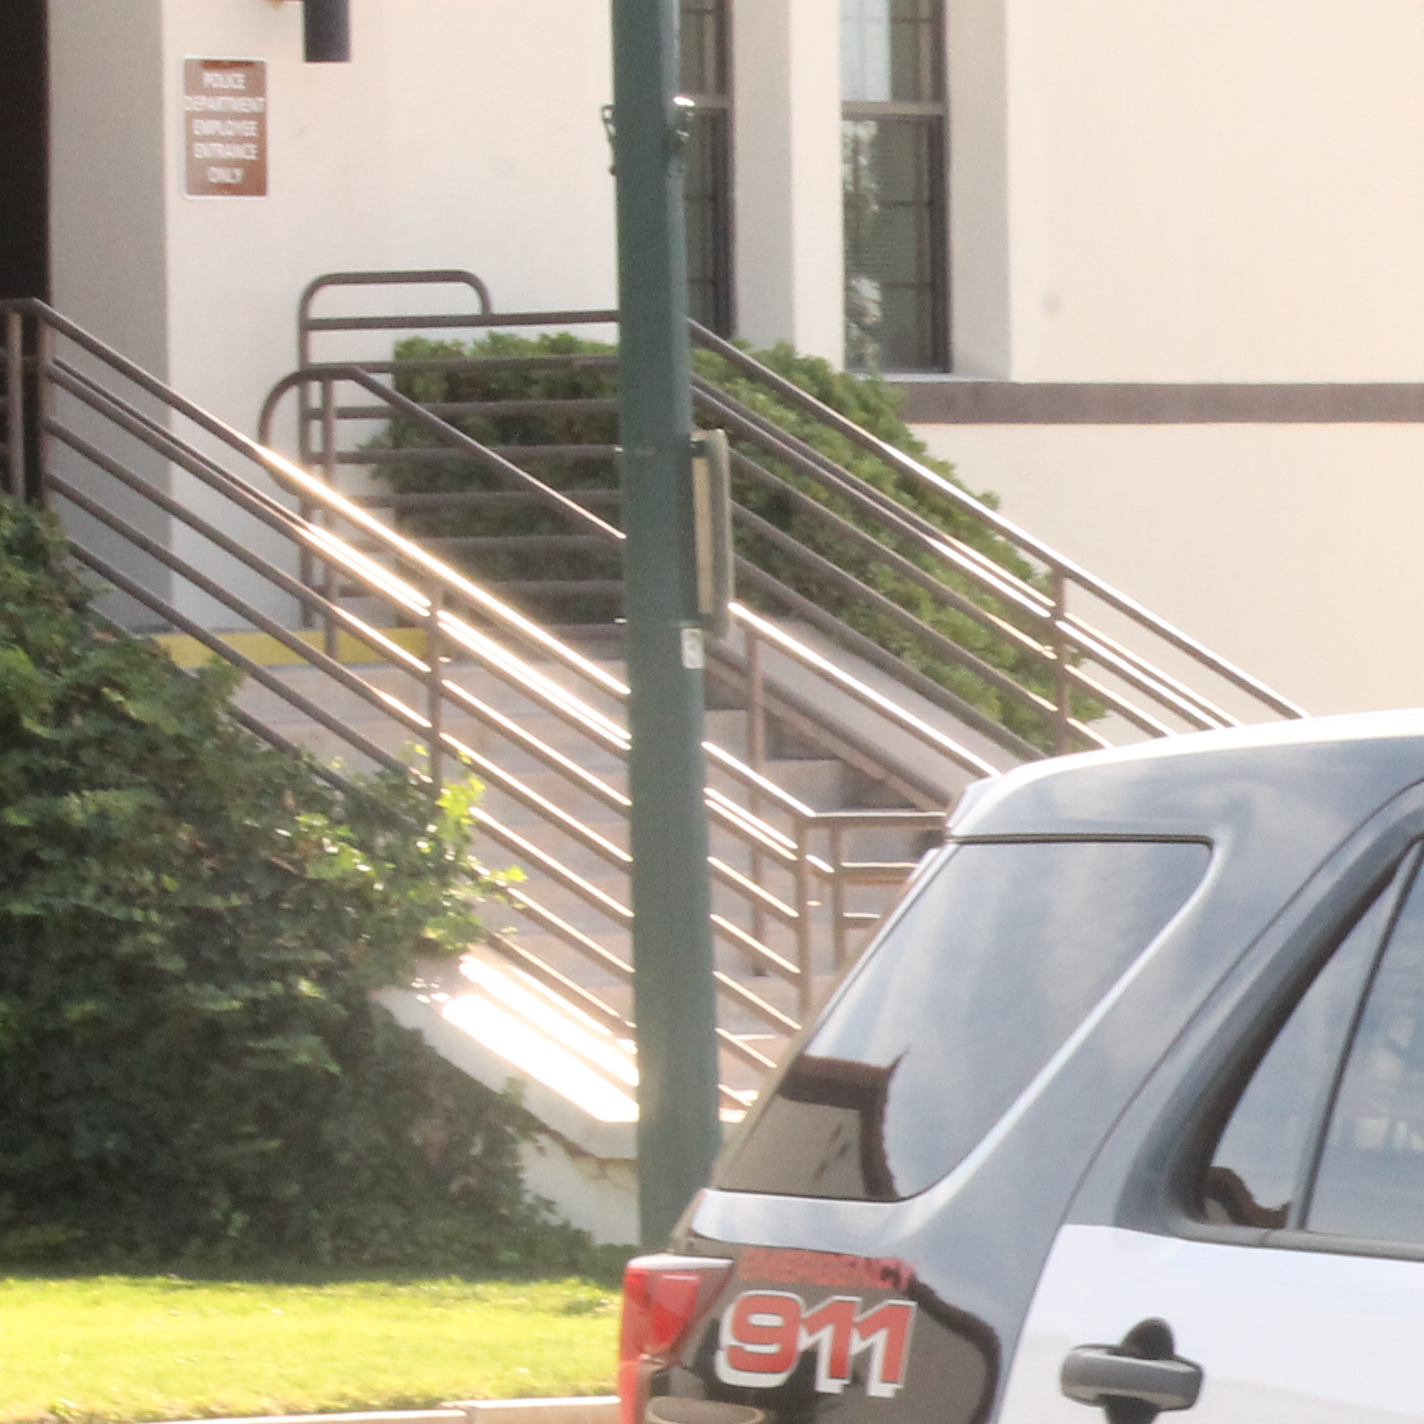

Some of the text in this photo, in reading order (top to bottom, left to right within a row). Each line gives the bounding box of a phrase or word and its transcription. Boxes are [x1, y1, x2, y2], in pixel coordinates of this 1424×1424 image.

[202, 72, 246, 90] POLICE
[184, 95, 266, 113] DEPARTMENT
[193, 119, 259, 137] EMPLOYEE
[193, 142, 259, 161] ENTRANCE
[207, 166, 244, 184] ONLY
[714, 1288, 918, 1399] 911
